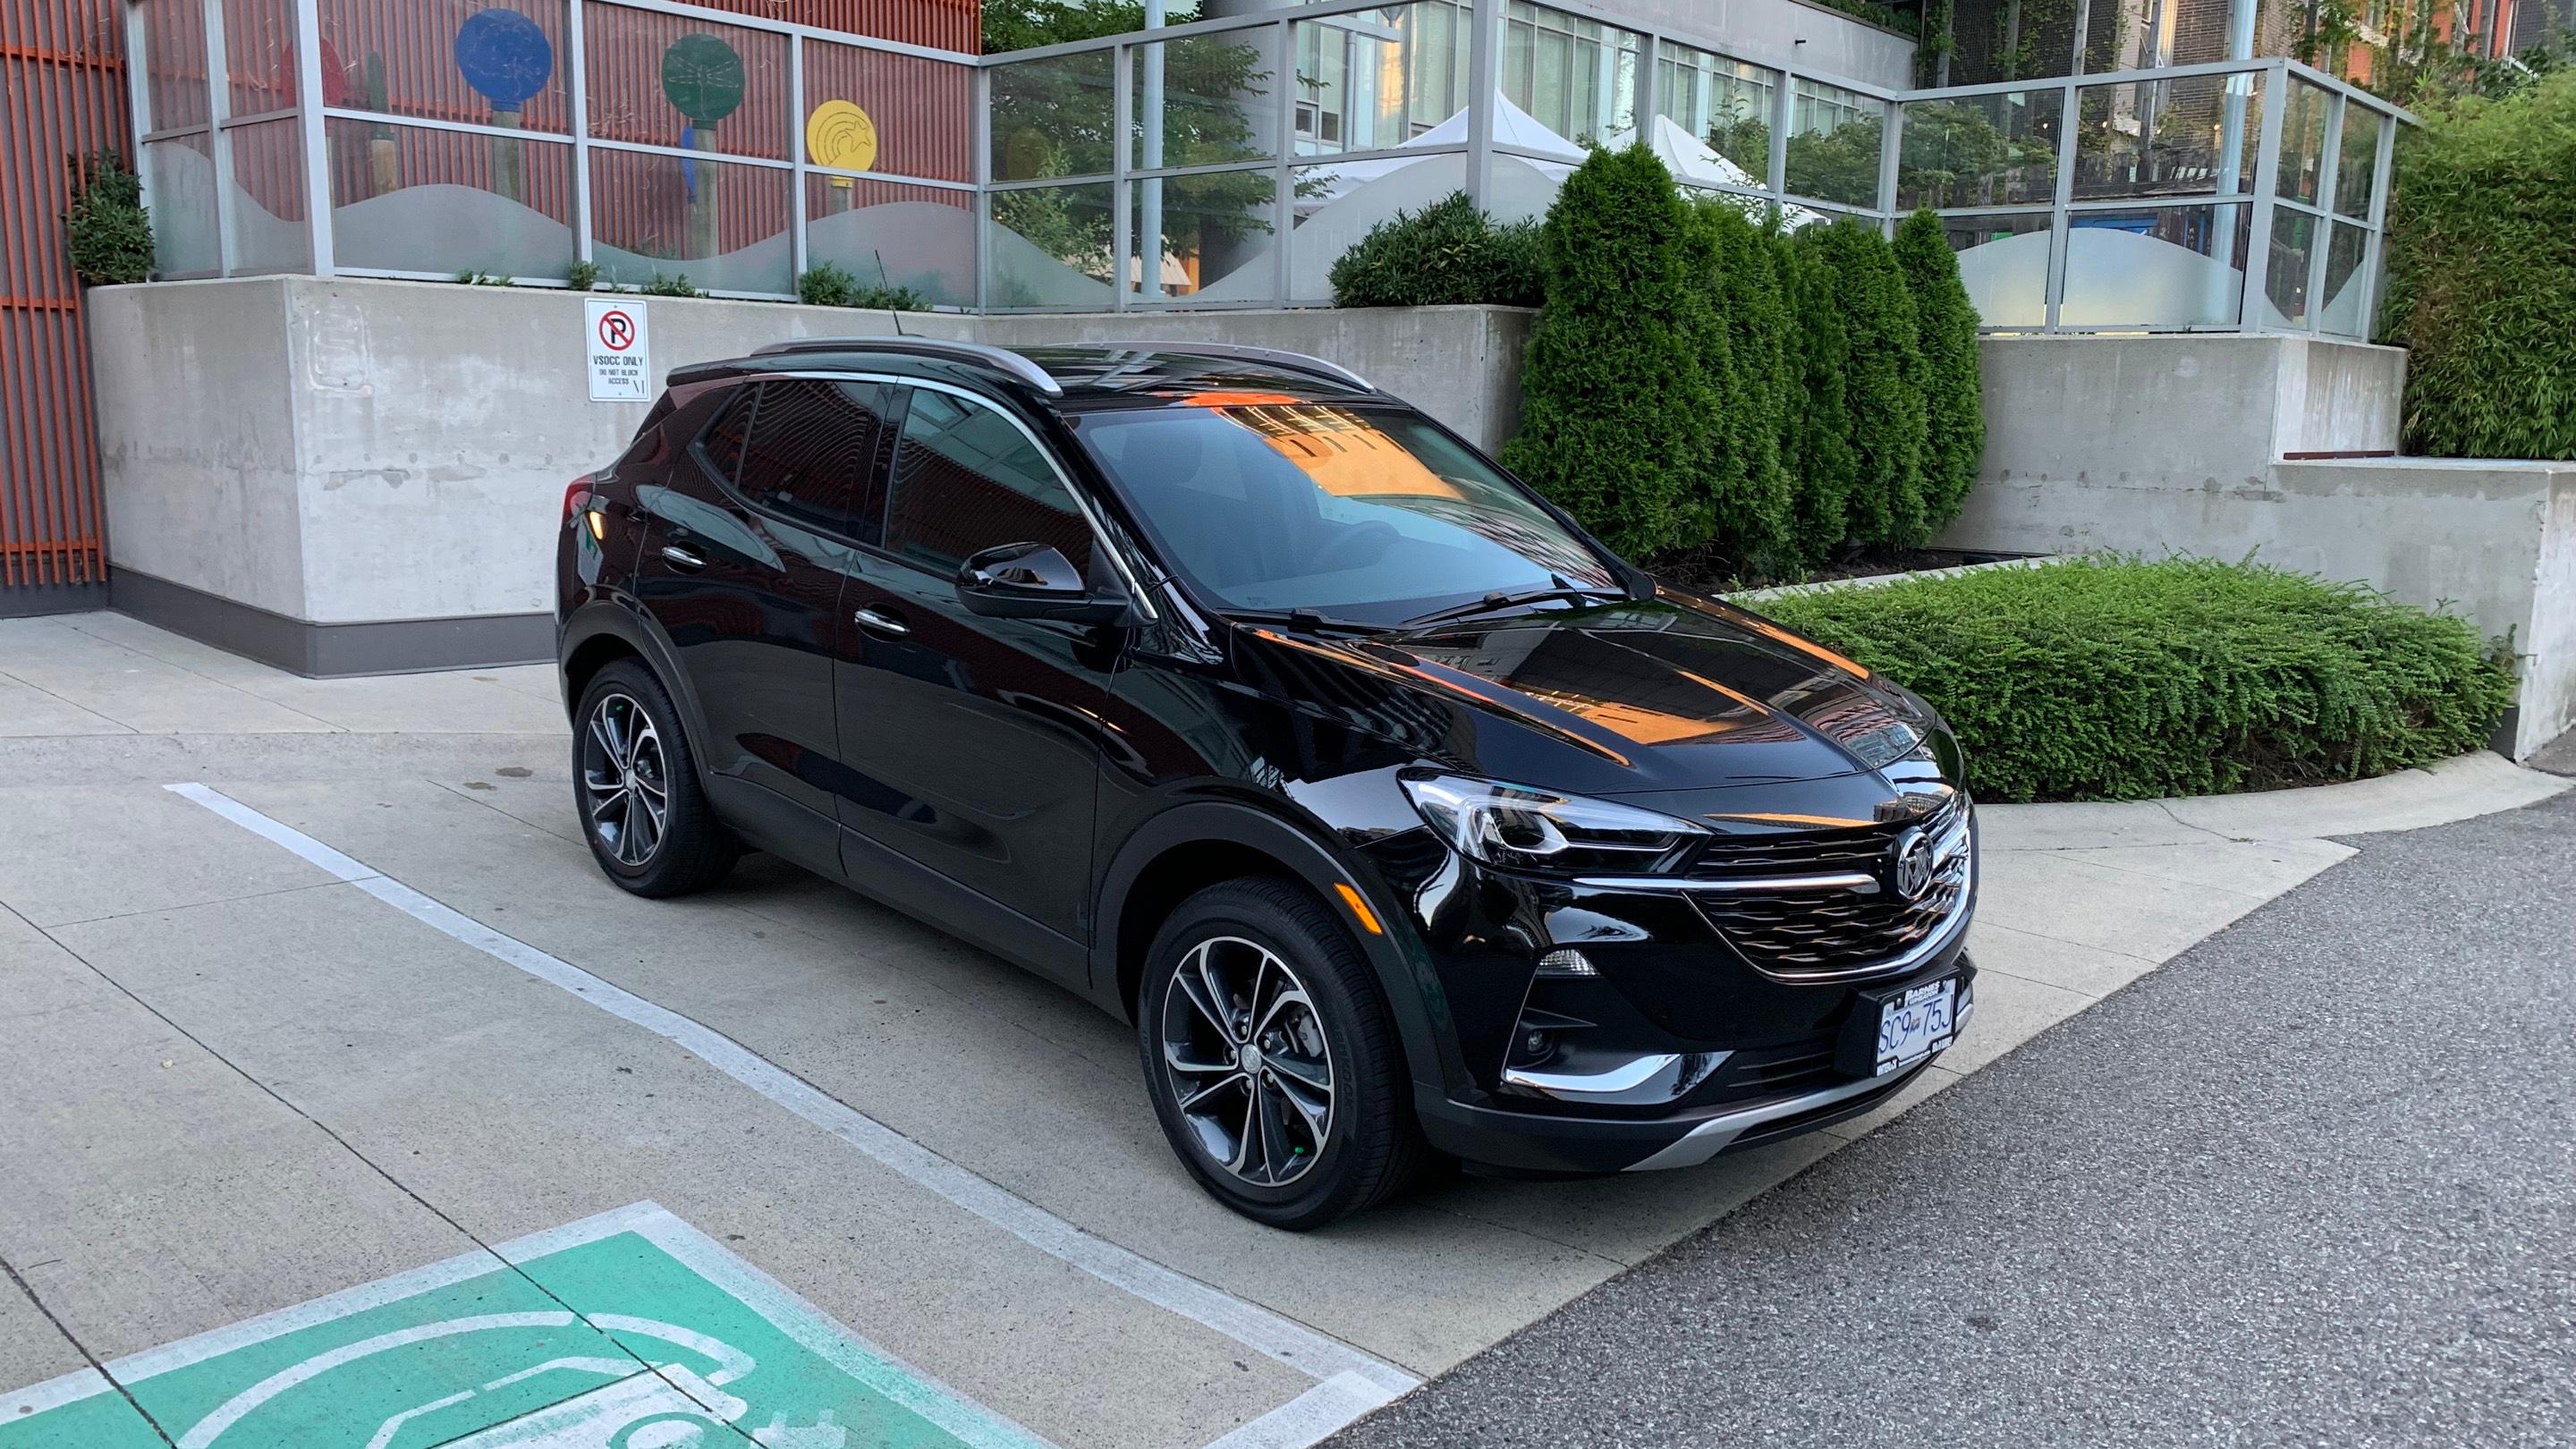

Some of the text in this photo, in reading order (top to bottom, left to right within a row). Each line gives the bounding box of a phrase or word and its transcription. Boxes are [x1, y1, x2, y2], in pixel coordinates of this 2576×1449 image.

[611, 318, 627, 344] P
[593, 355, 643, 366] VSOCC ONLY
